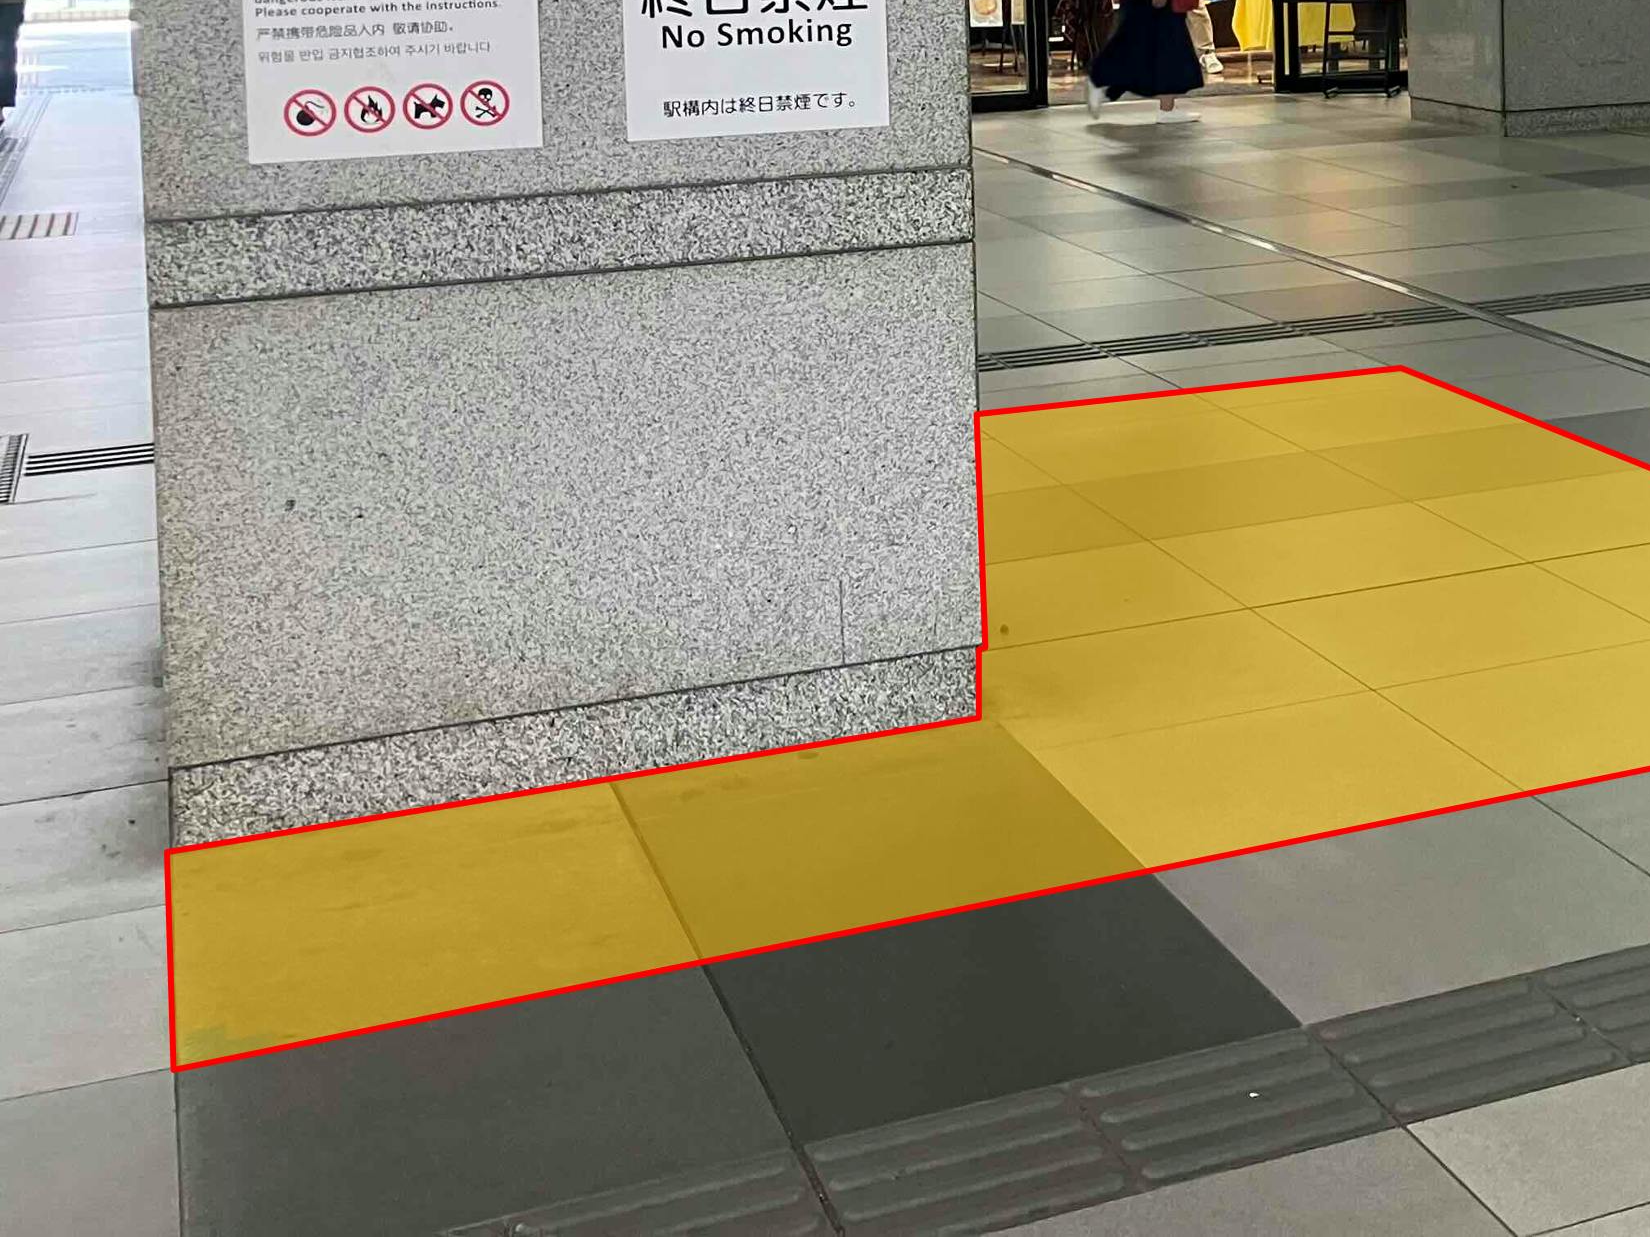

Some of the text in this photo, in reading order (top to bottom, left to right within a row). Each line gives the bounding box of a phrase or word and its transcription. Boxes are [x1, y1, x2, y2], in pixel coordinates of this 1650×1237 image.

[254, 6, 298, 18] Please
[300, 4, 367, 18] cooperate
[369, 1, 398, 13] with
[401, 1, 422, 12] the
[661, 18, 853, 49] No Smoking
[663, 91, 857, 118] 駅構内は終日禁煙です。
